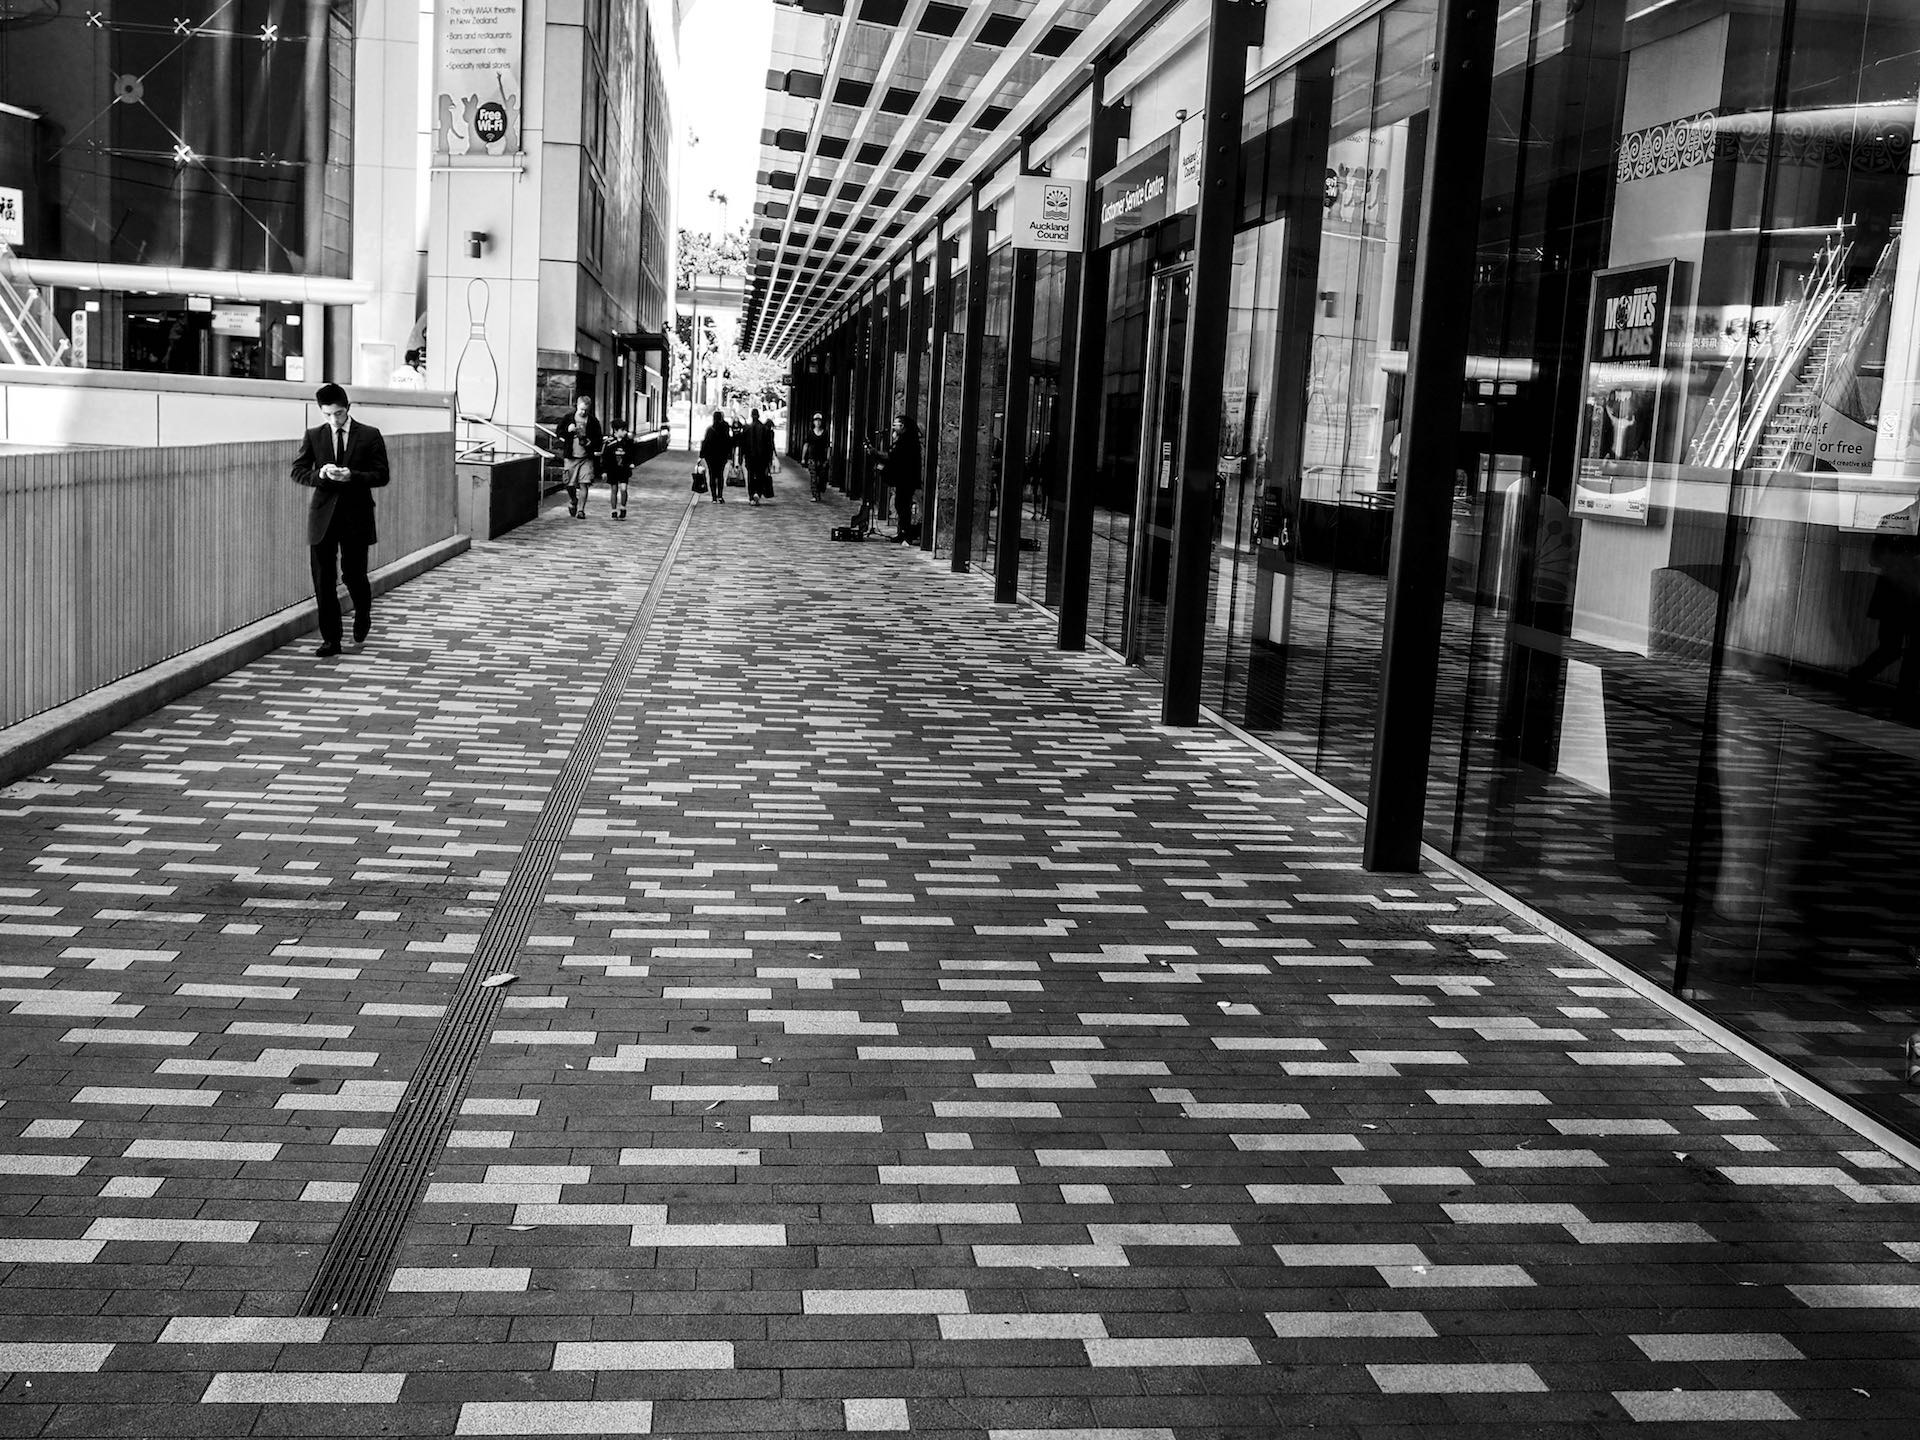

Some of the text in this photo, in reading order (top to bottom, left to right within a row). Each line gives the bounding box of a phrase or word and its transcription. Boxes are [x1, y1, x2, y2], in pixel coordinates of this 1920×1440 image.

[462, 7, 475, 15] only
[475, 6, 493, 14] IMAX
[493, 6, 516, 14] theatre
[456, 17, 471, 25] New
[472, 16, 498, 25] Zealand
[449, 32, 463, 40] Bars
[477, 31, 512, 40] restaurants
[449, 47, 486, 55] Amusement
[475, 61, 491, 69] retail
[479, 108, 502, 120] Free
[477, 119, 503, 132] Wi-Fi
[1101, 175, 1165, 225] Customer Service Centre
[1029, 221, 1069, 232] Auckland
[1036, 230, 1069, 240] Council
[1604, 292, 1658, 331] MOVIES
[1614, 327, 1655, 357] PARKS
[1837, 440, 1863, 455] free
